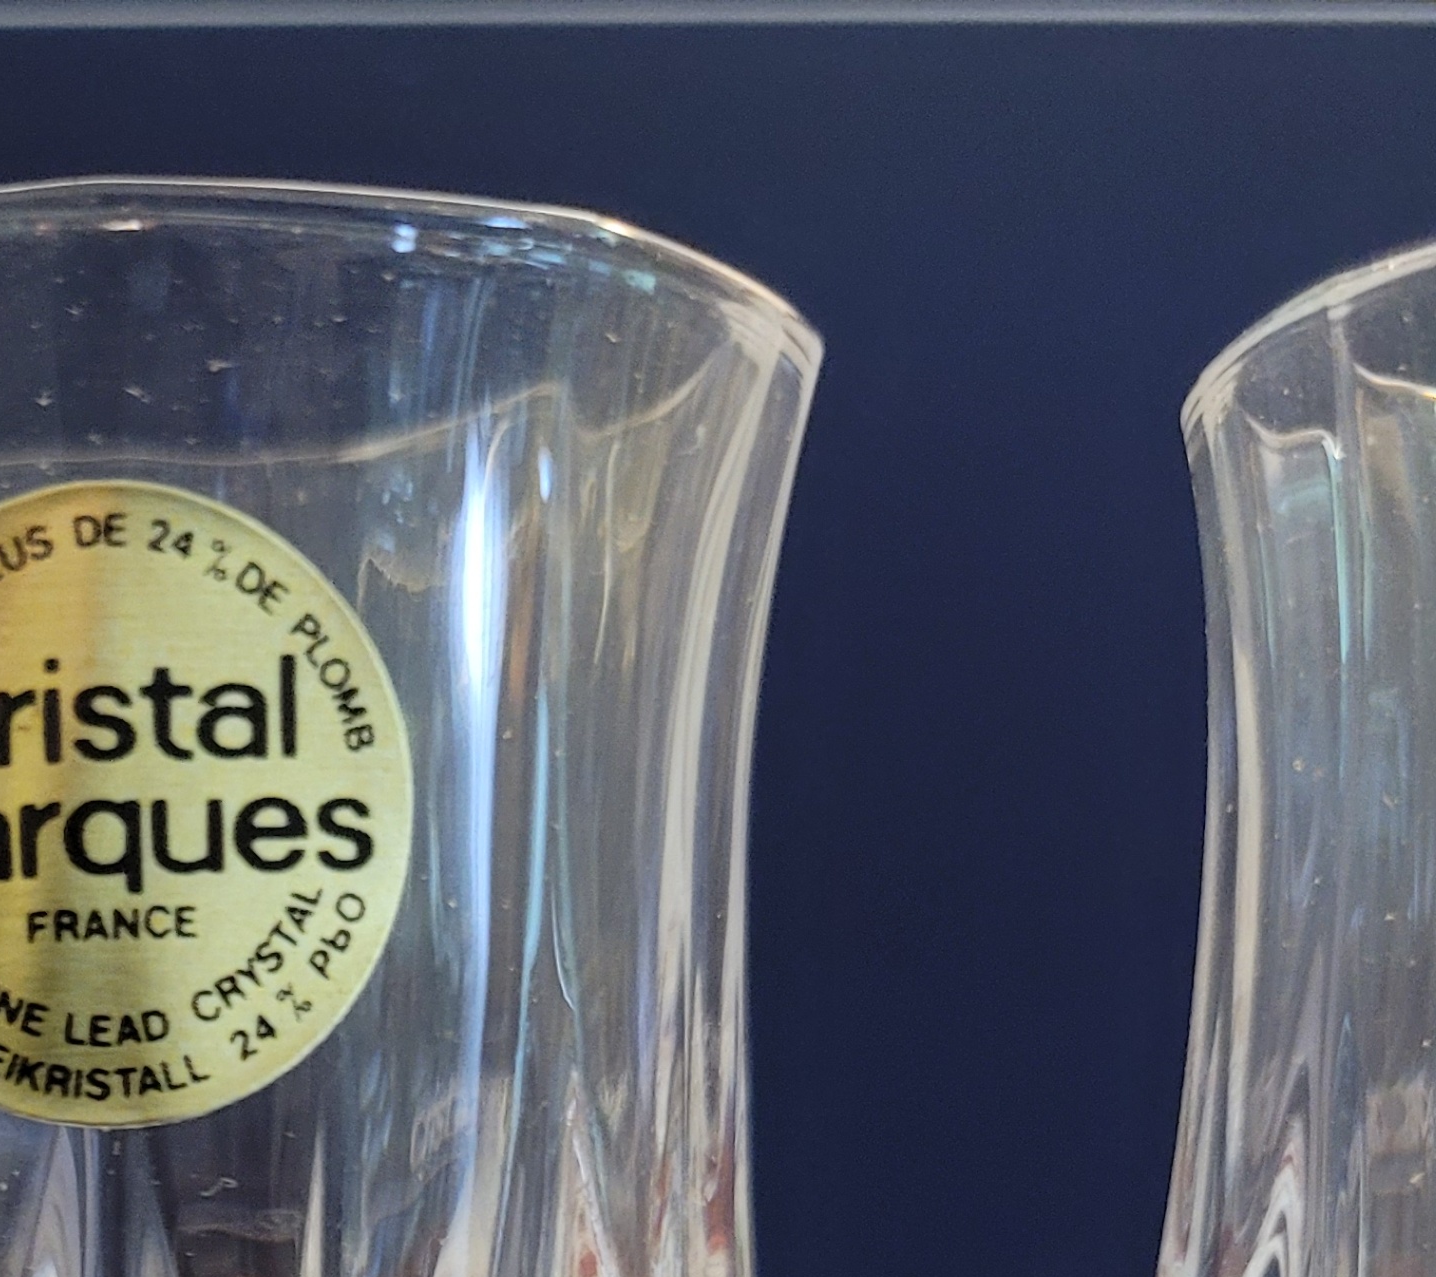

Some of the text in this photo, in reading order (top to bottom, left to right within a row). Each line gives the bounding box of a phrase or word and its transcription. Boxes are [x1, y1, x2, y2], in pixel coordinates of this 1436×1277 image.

[74, 512, 128, 550] DE
[236, 561, 289, 615] DE
[291, 613, 376, 753] PLOMB
[26, 905, 199, 944] FRANCE
[65, 1009, 171, 1048] LEAD
[191, 885, 324, 1024] CRYSTAL
